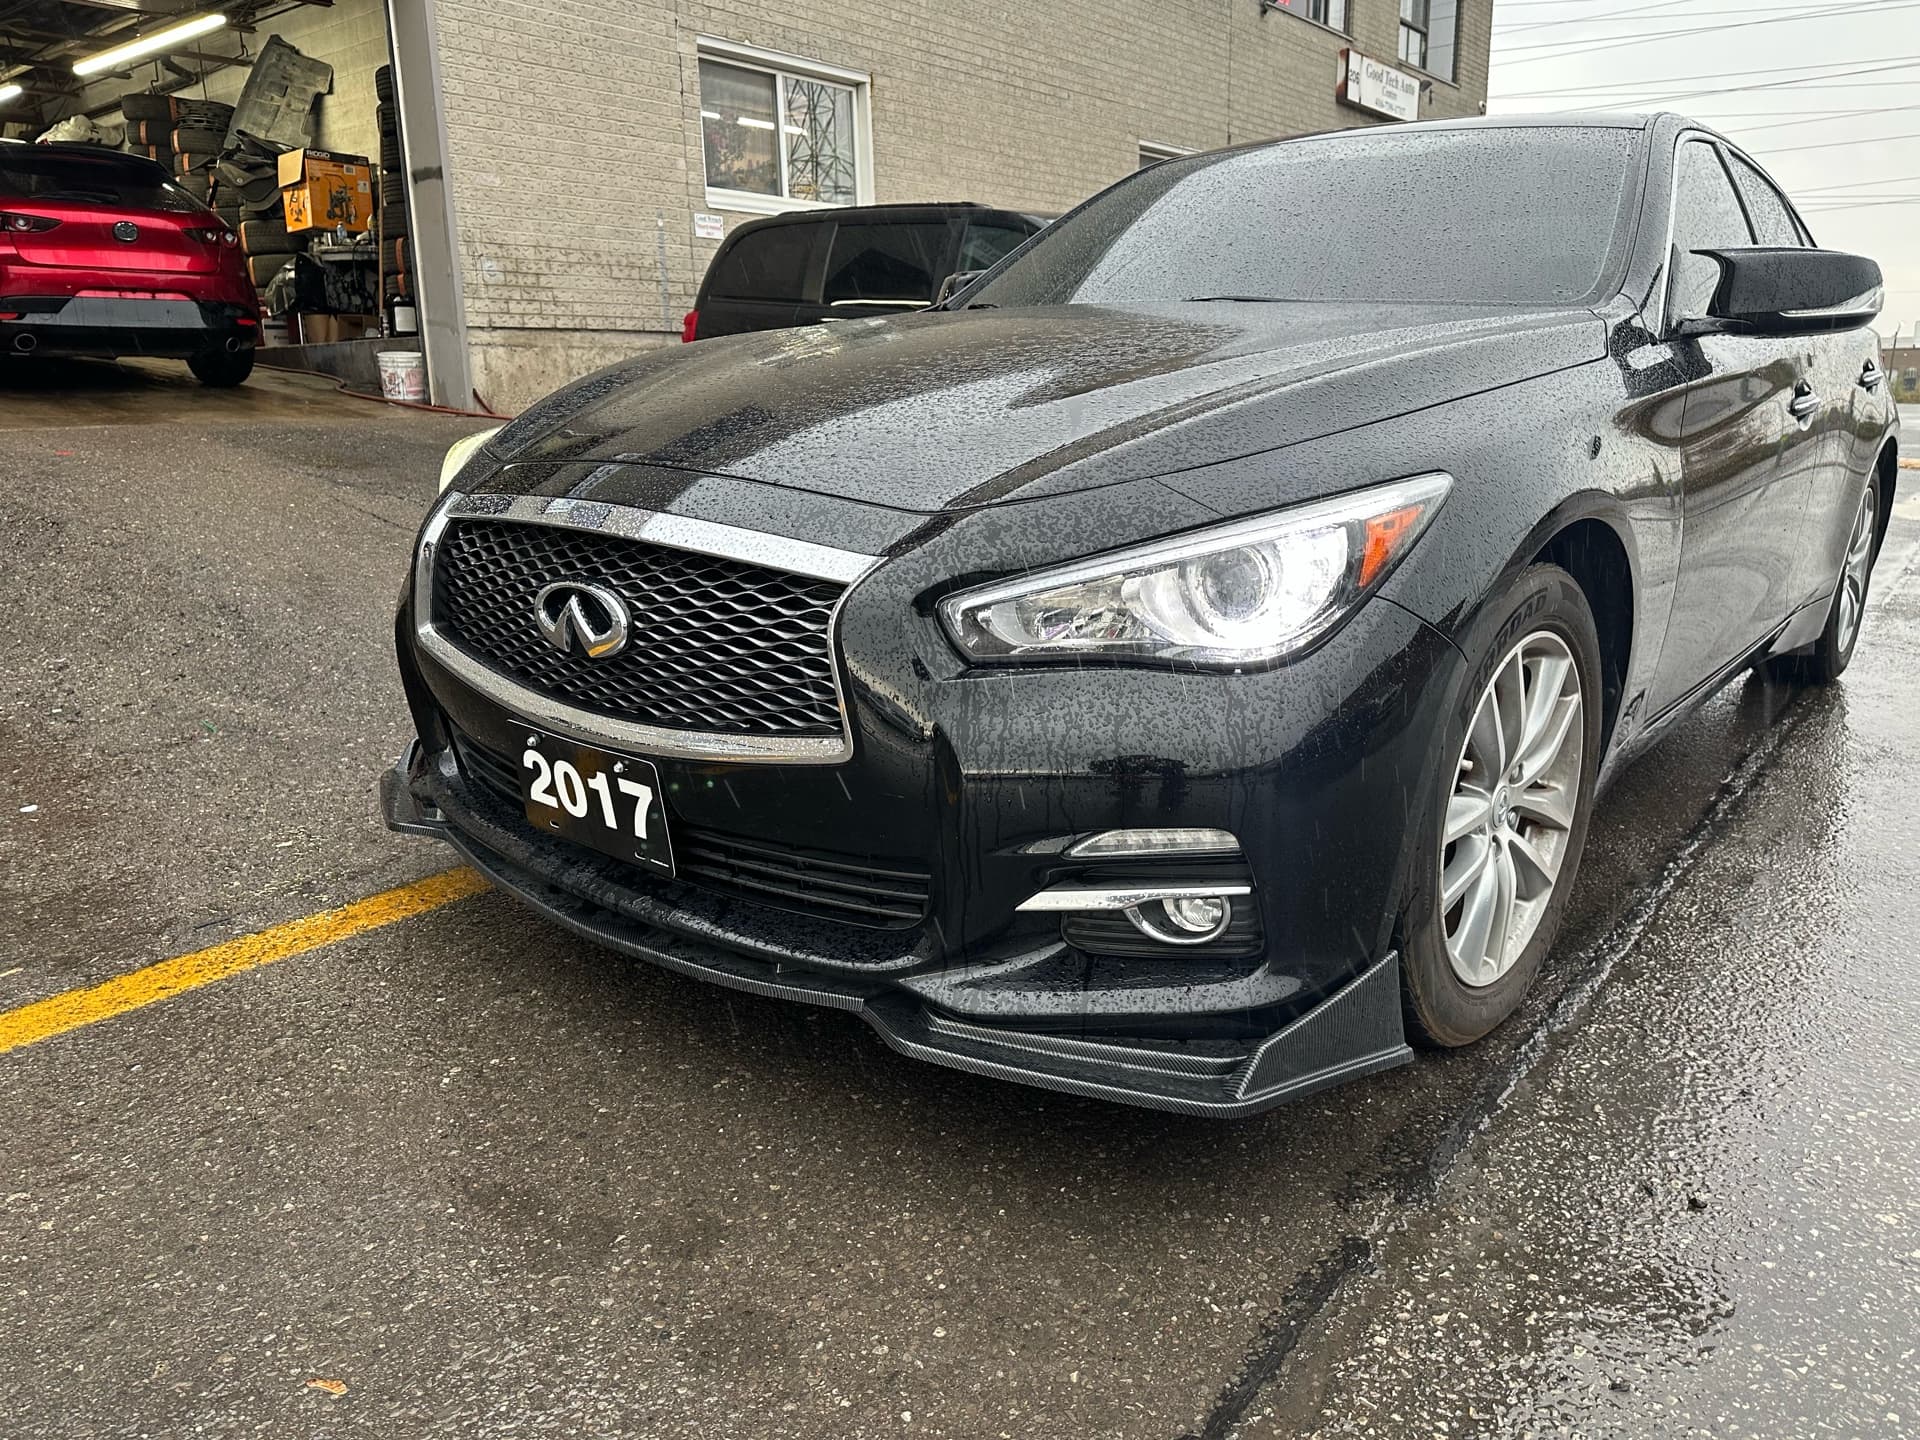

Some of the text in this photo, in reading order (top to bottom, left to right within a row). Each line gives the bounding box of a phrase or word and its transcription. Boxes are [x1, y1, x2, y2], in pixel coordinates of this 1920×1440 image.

[1366, 63, 1415, 96] Good Tech Auto
[523, 749, 653, 840] 2017
